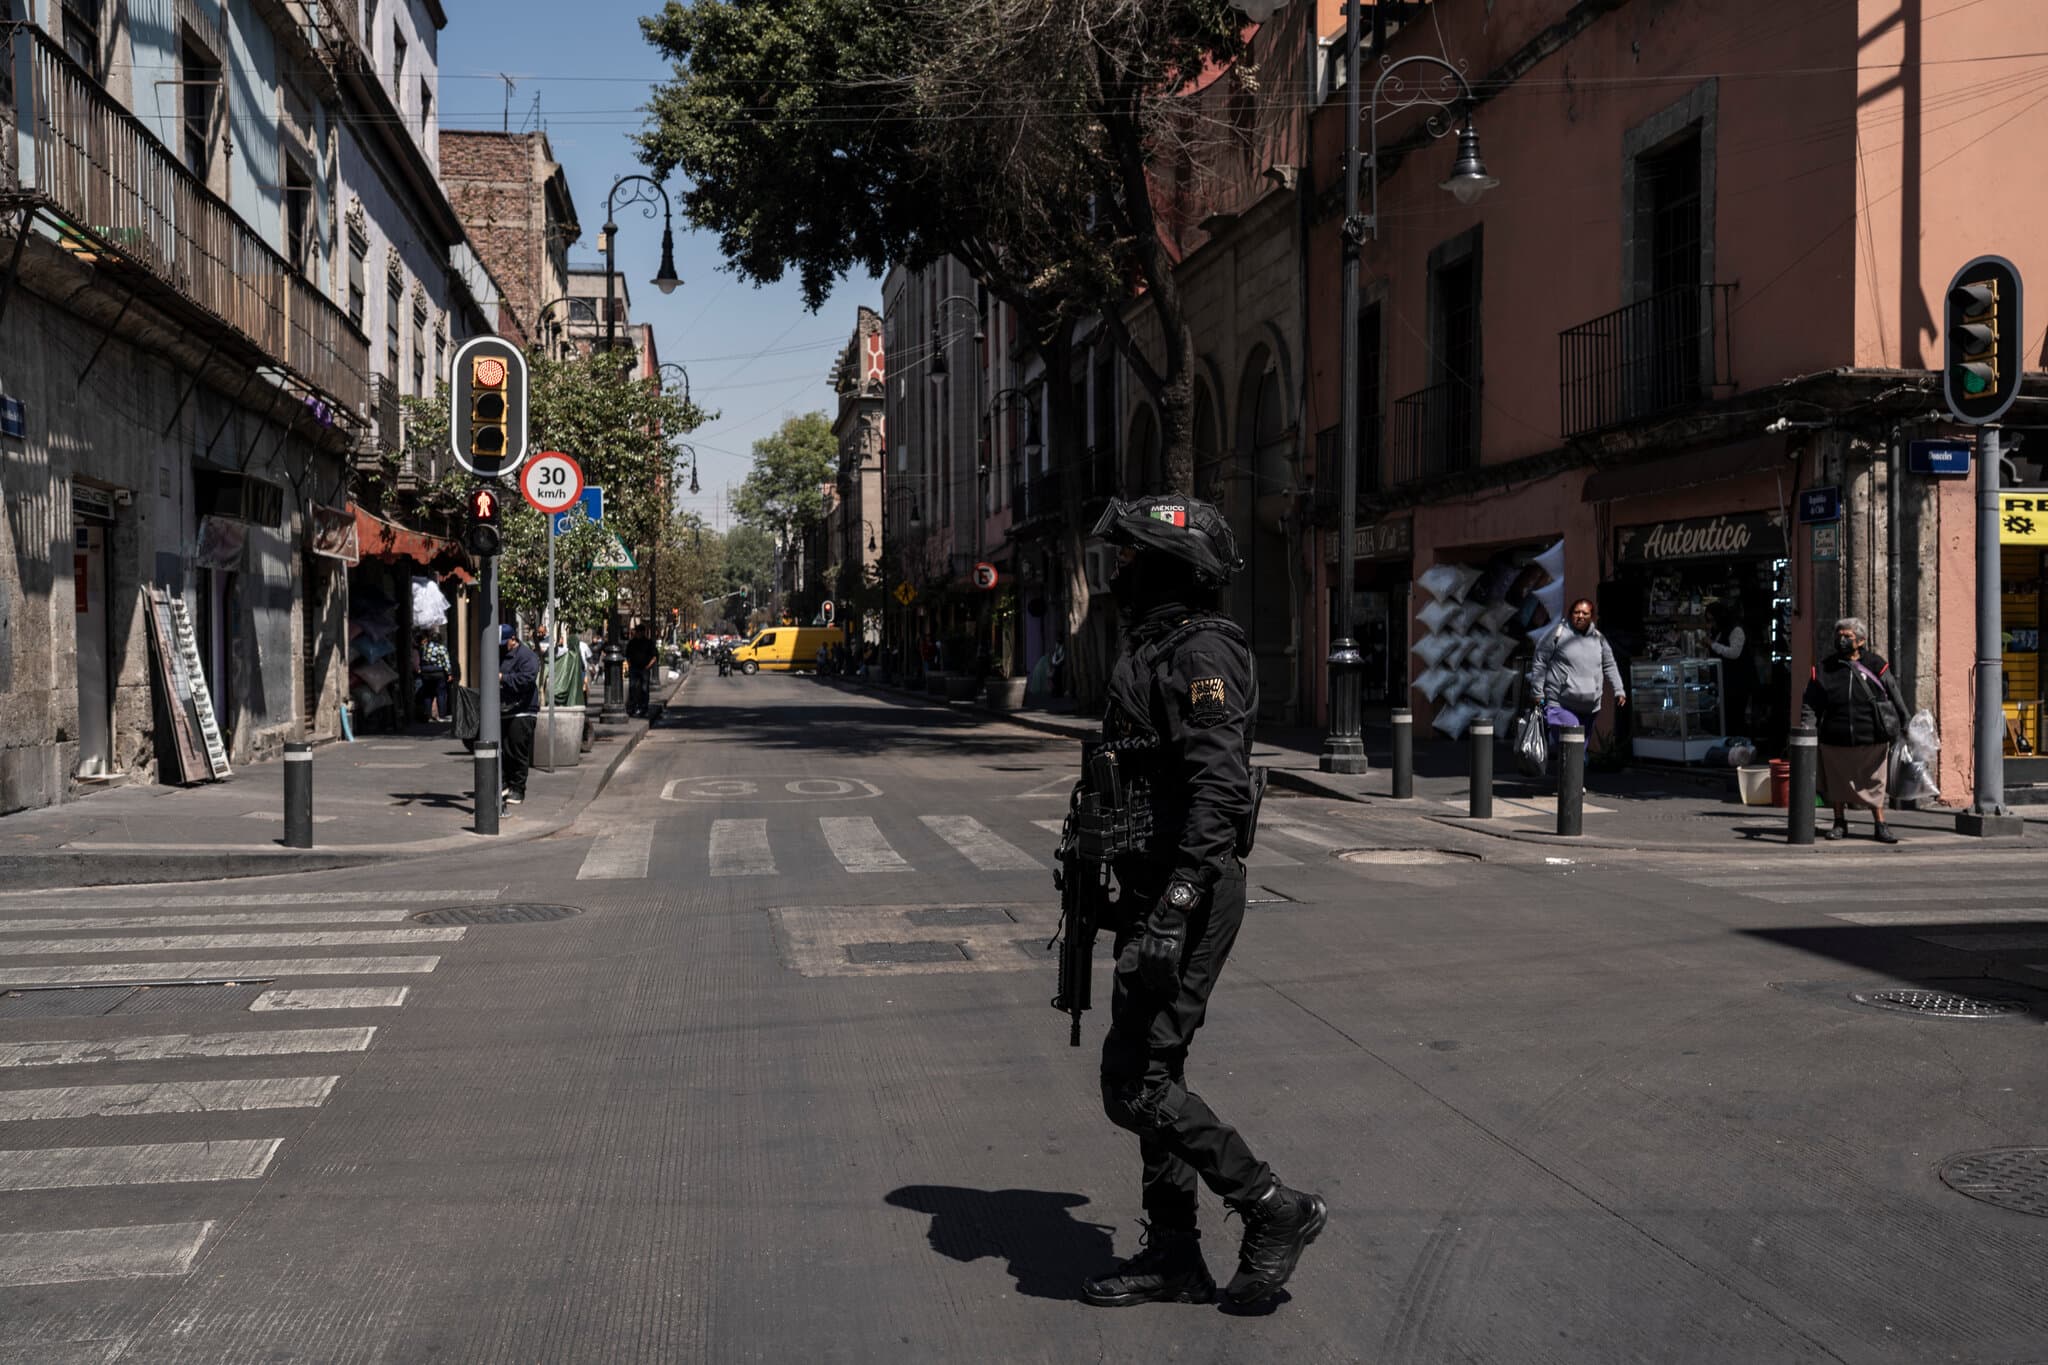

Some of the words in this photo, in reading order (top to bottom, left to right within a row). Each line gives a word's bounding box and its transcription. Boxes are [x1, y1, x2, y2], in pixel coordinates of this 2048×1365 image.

[539, 467, 565, 485] 30
[538, 488, 566, 499] km/h
[1643, 515, 1752, 560] Autentica
